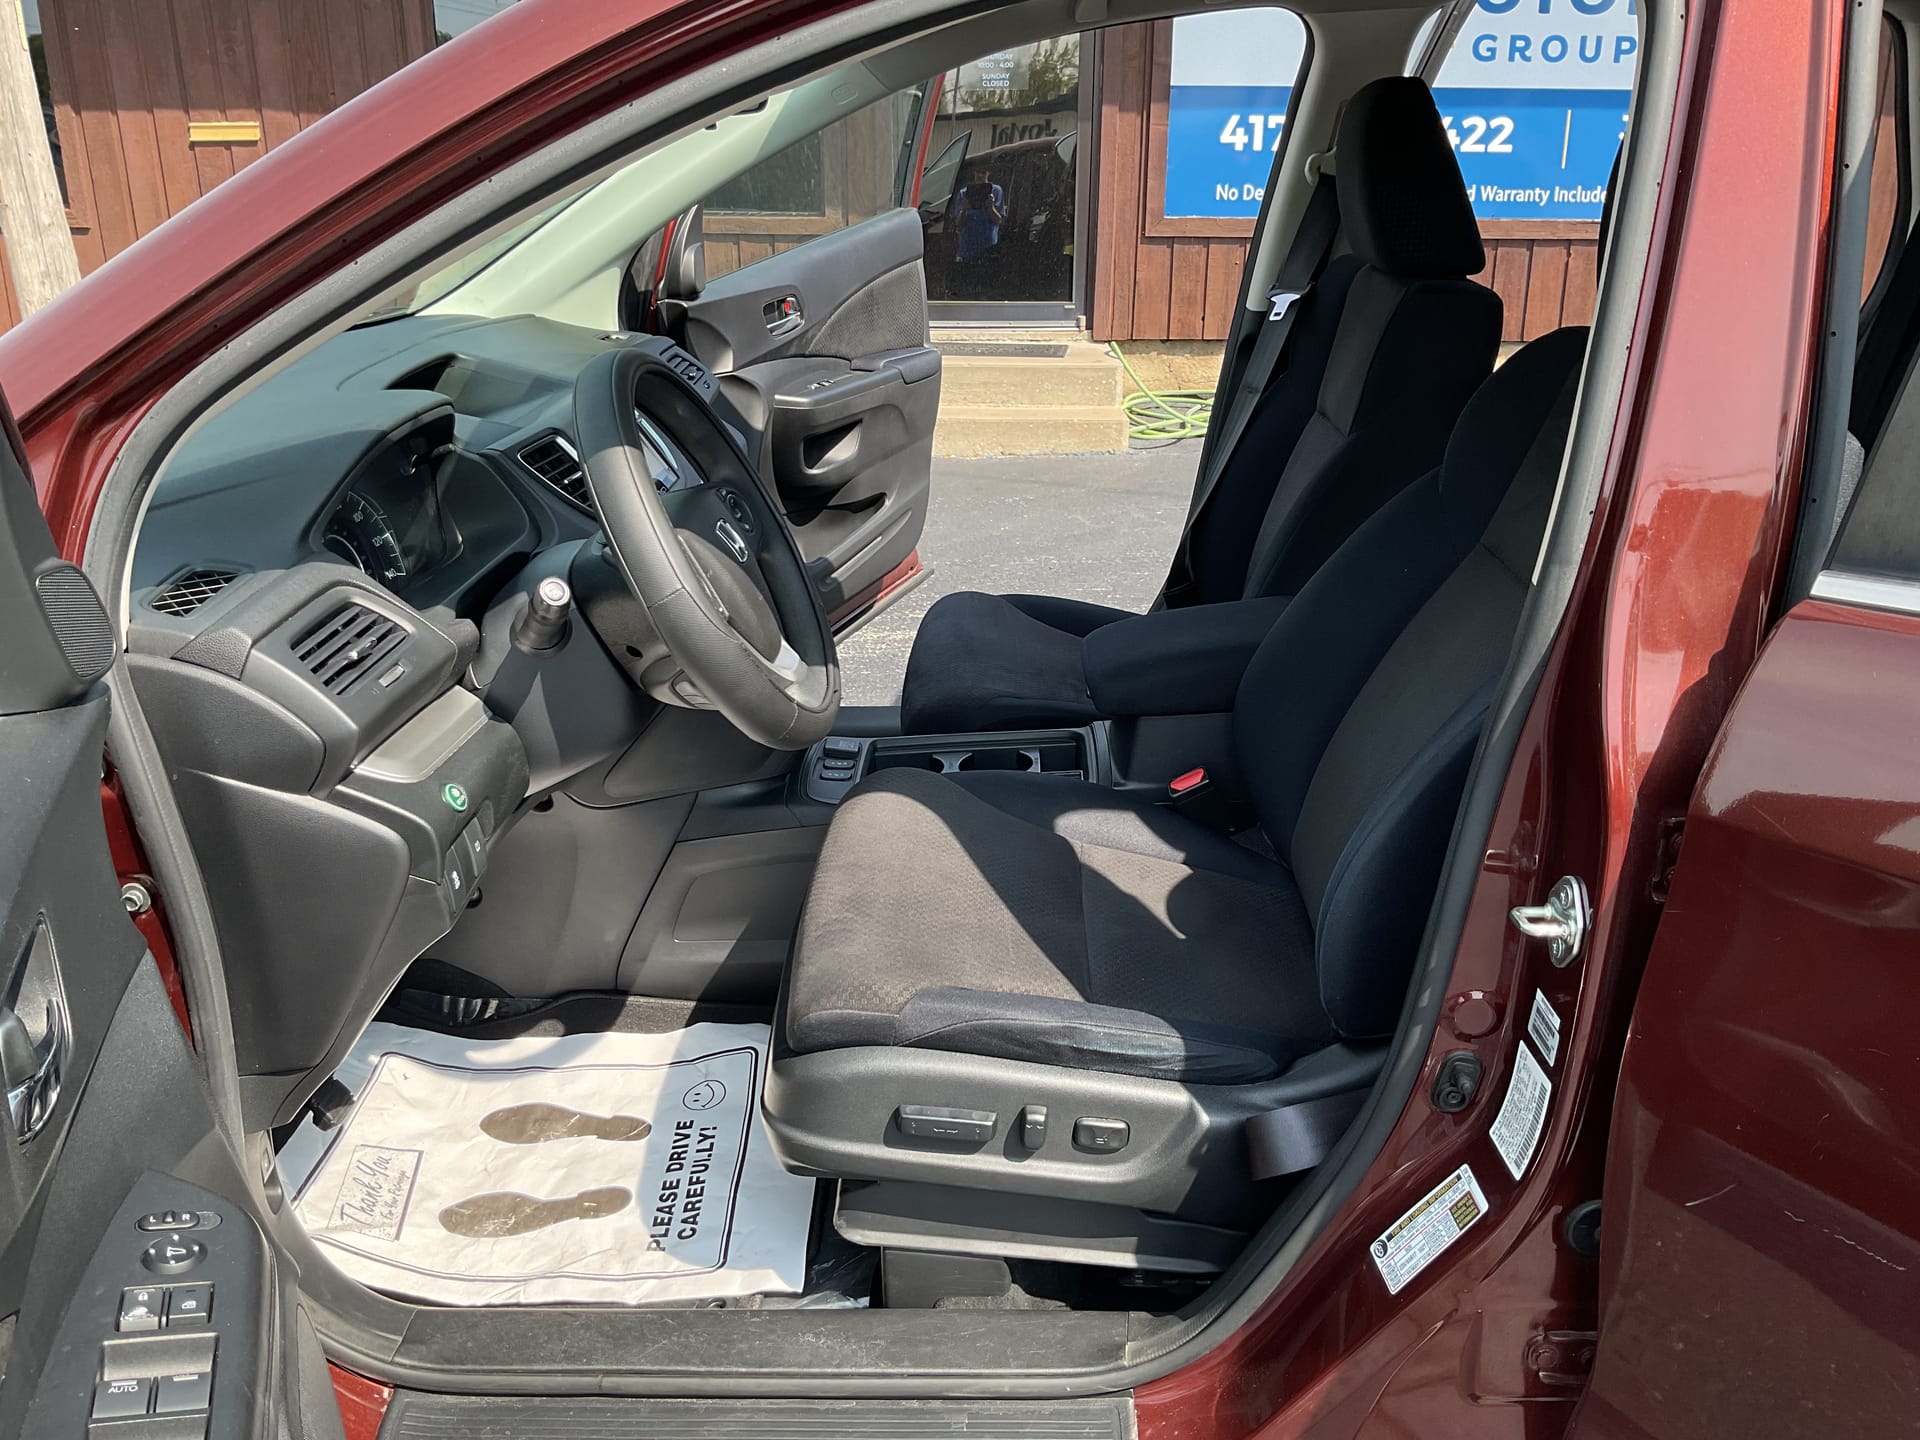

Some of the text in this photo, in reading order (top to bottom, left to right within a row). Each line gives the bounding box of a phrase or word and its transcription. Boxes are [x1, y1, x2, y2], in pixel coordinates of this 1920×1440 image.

[1472, 34, 1637, 63] GROUP
[1216, 183, 1239, 201] No
[1480, 185, 1550, 207] Warranty
[1554, 185, 1607, 203] Include
[340, 1155, 393, 1226] Thank You
[646, 1119, 695, 1251] PLEASE DRIVE
[149, 1213, 191, 1223] L R
[107, 1384, 138, 1394] AUTO
